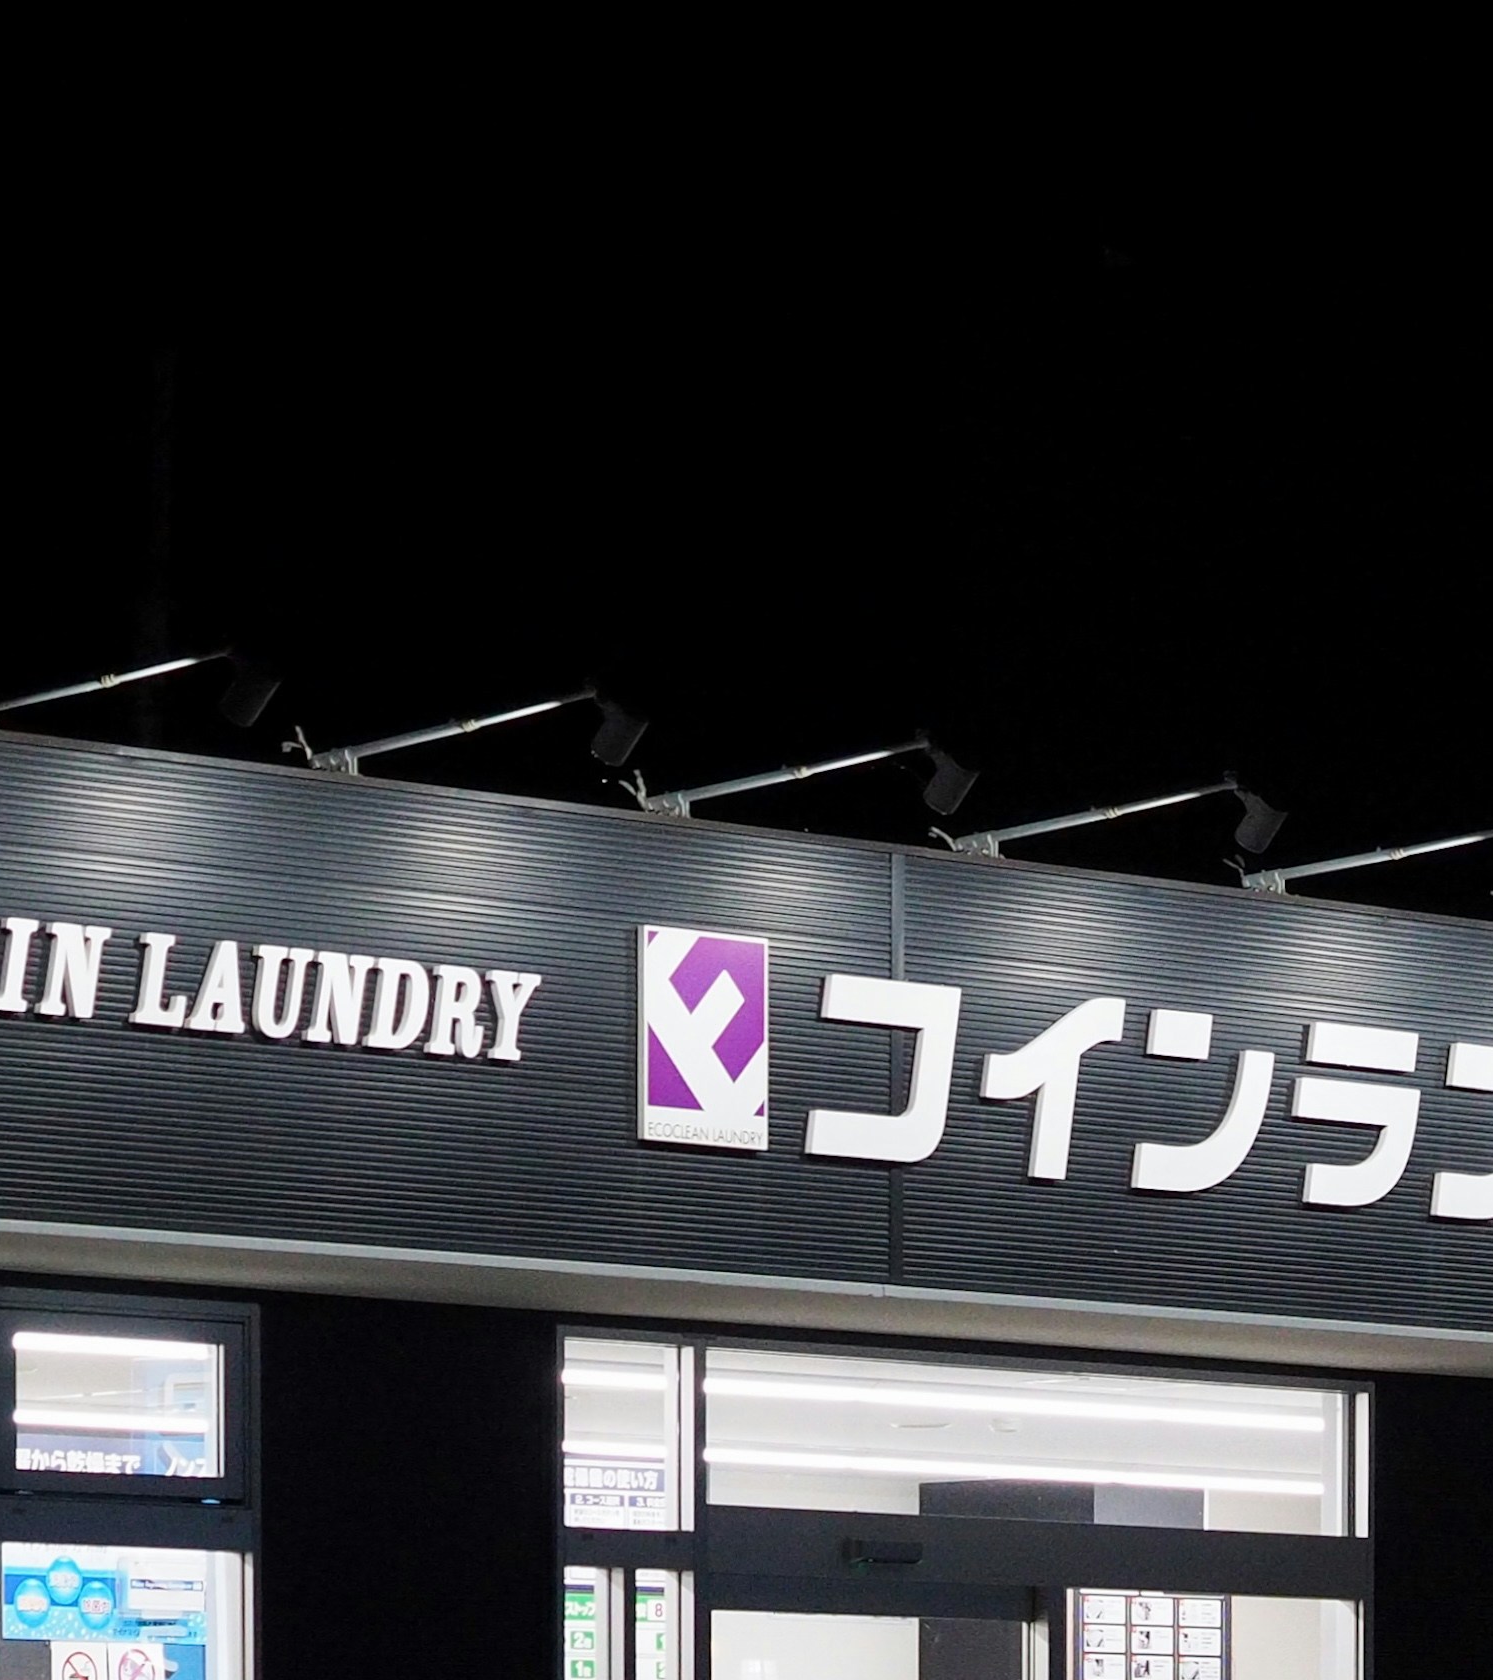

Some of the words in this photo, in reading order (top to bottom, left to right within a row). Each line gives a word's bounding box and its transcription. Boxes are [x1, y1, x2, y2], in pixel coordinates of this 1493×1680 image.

[129, 931, 542, 1062] LAUNDRY
[647, 1121, 709, 1141] ECOCLEAN
[712, 1128, 764, 1146] LAUNDRY
[654, 1602, 664, 1617] 8
